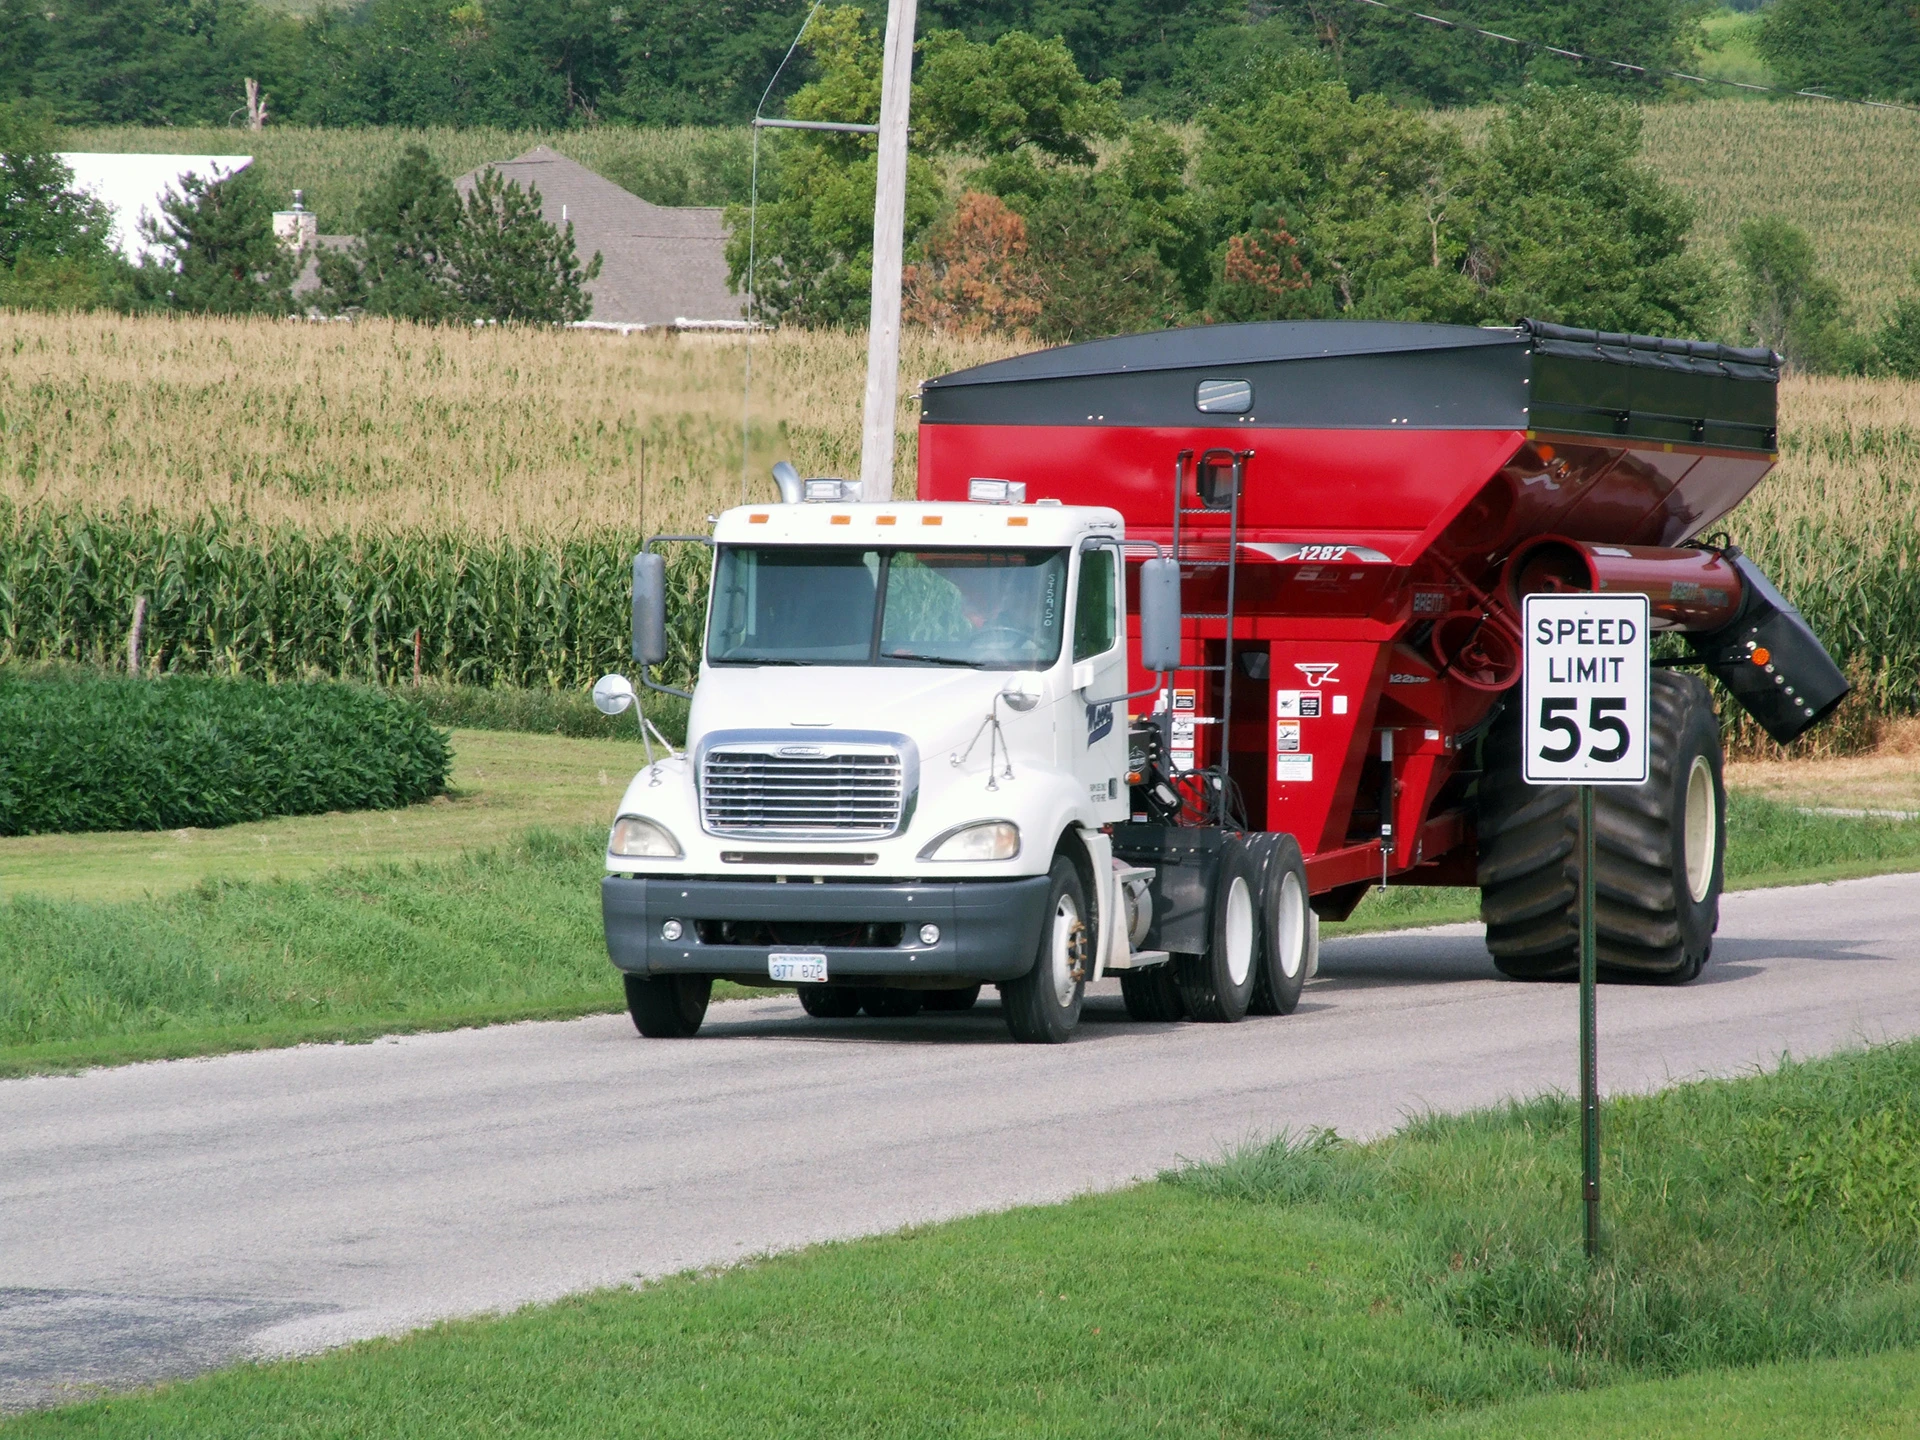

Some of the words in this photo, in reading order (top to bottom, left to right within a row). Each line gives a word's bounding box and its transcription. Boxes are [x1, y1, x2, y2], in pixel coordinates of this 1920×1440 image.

[1299, 546, 1348, 561] 1282
[1536, 618, 1636, 645] SPEED
[1549, 657, 1625, 683] LIMIT
[1539, 697, 1630, 763] 55
[773, 964, 794, 979] 377
